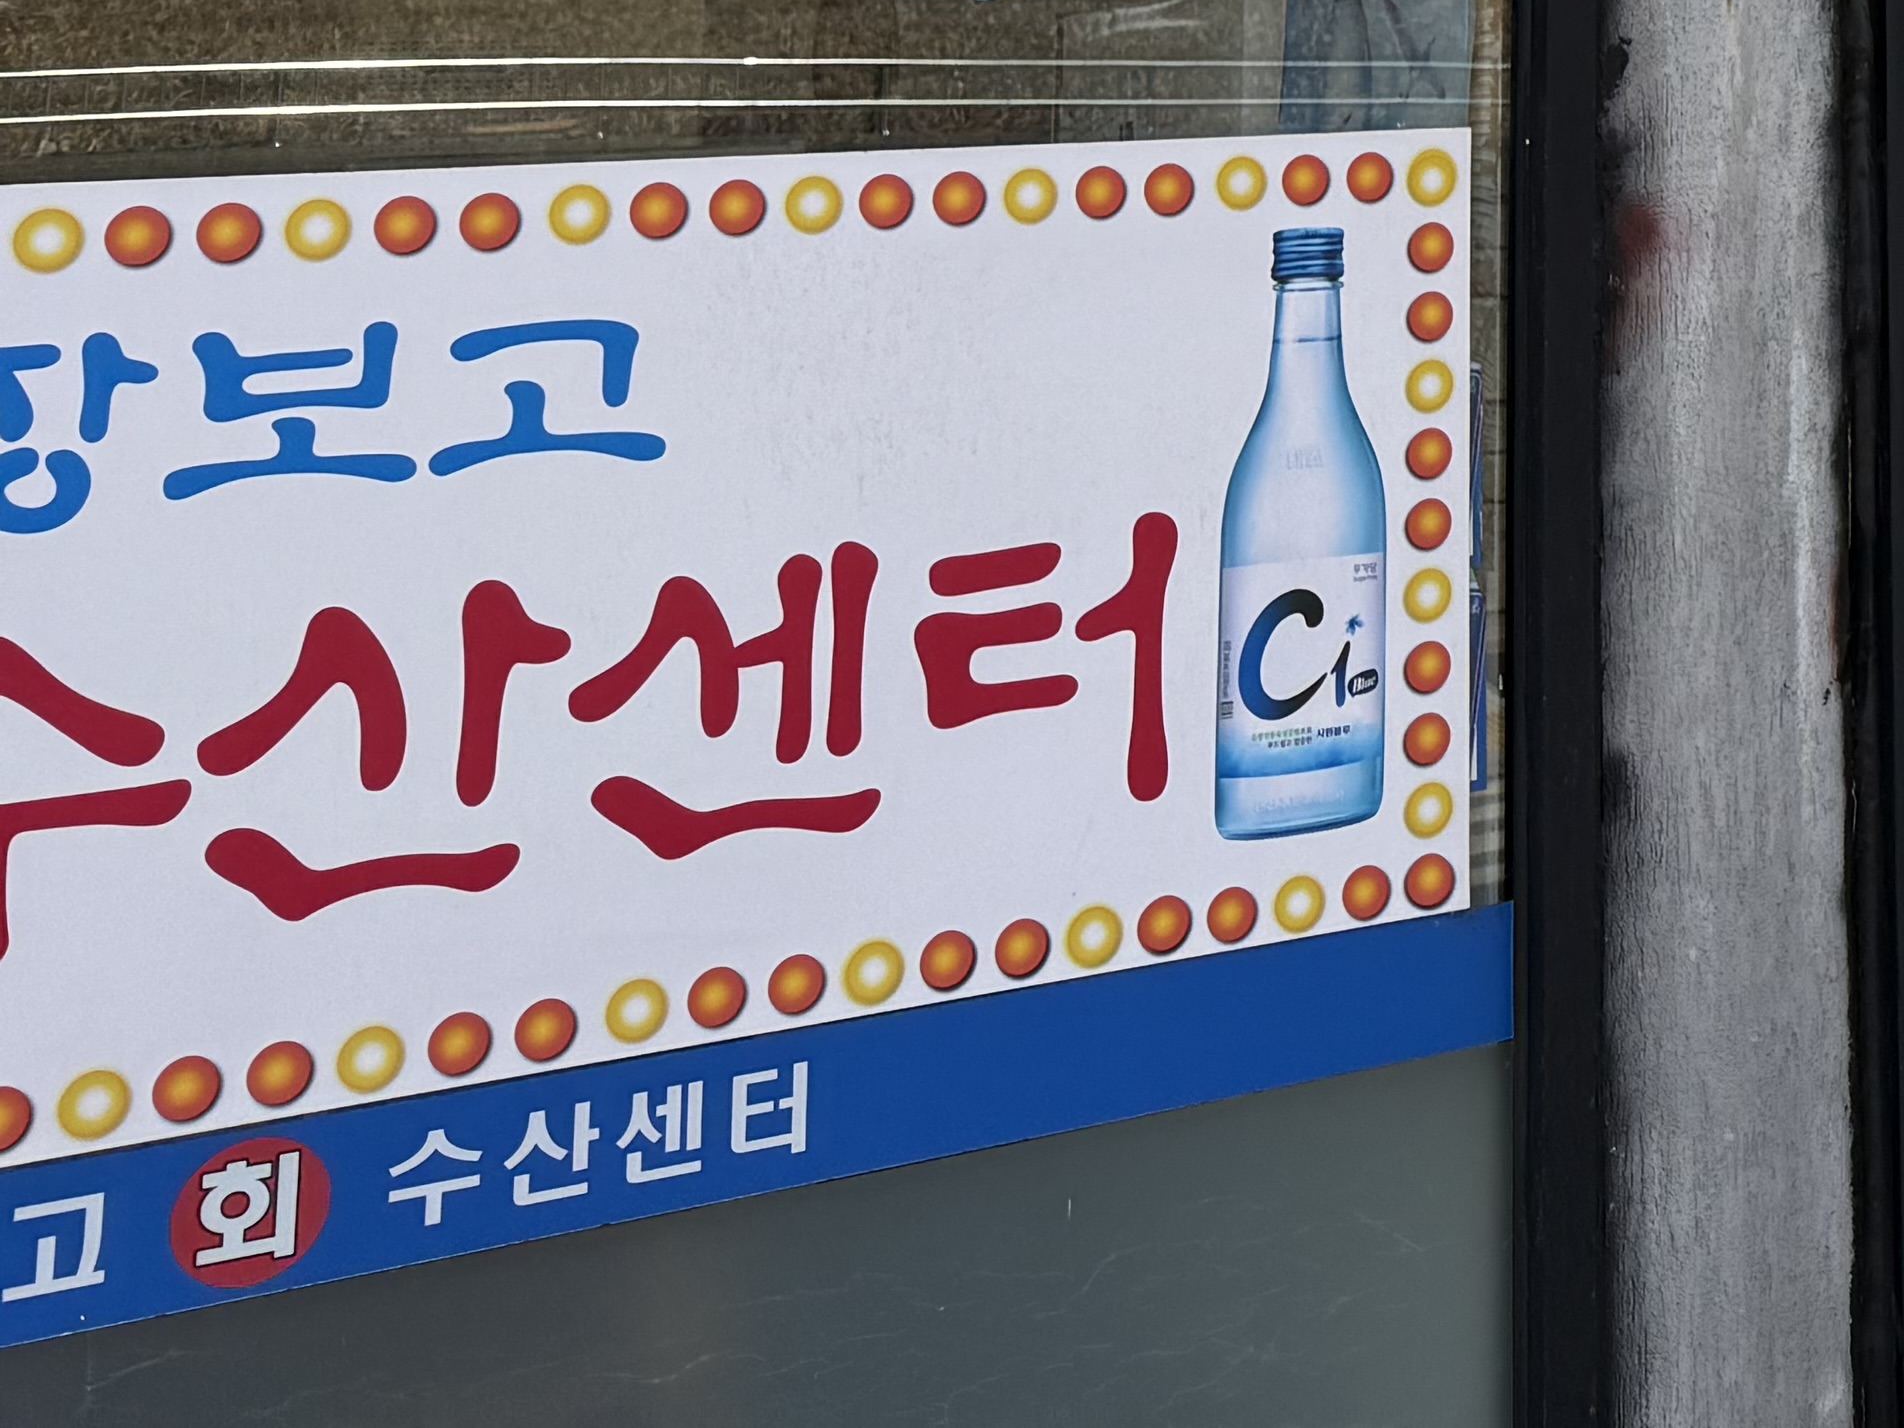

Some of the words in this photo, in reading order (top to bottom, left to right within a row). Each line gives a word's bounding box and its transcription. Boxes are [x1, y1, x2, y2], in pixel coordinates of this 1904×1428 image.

[3, 1194, 105, 1306] 고
[195, 1136, 302, 1270] 회
[387, 1061, 810, 1227] 수산센터
